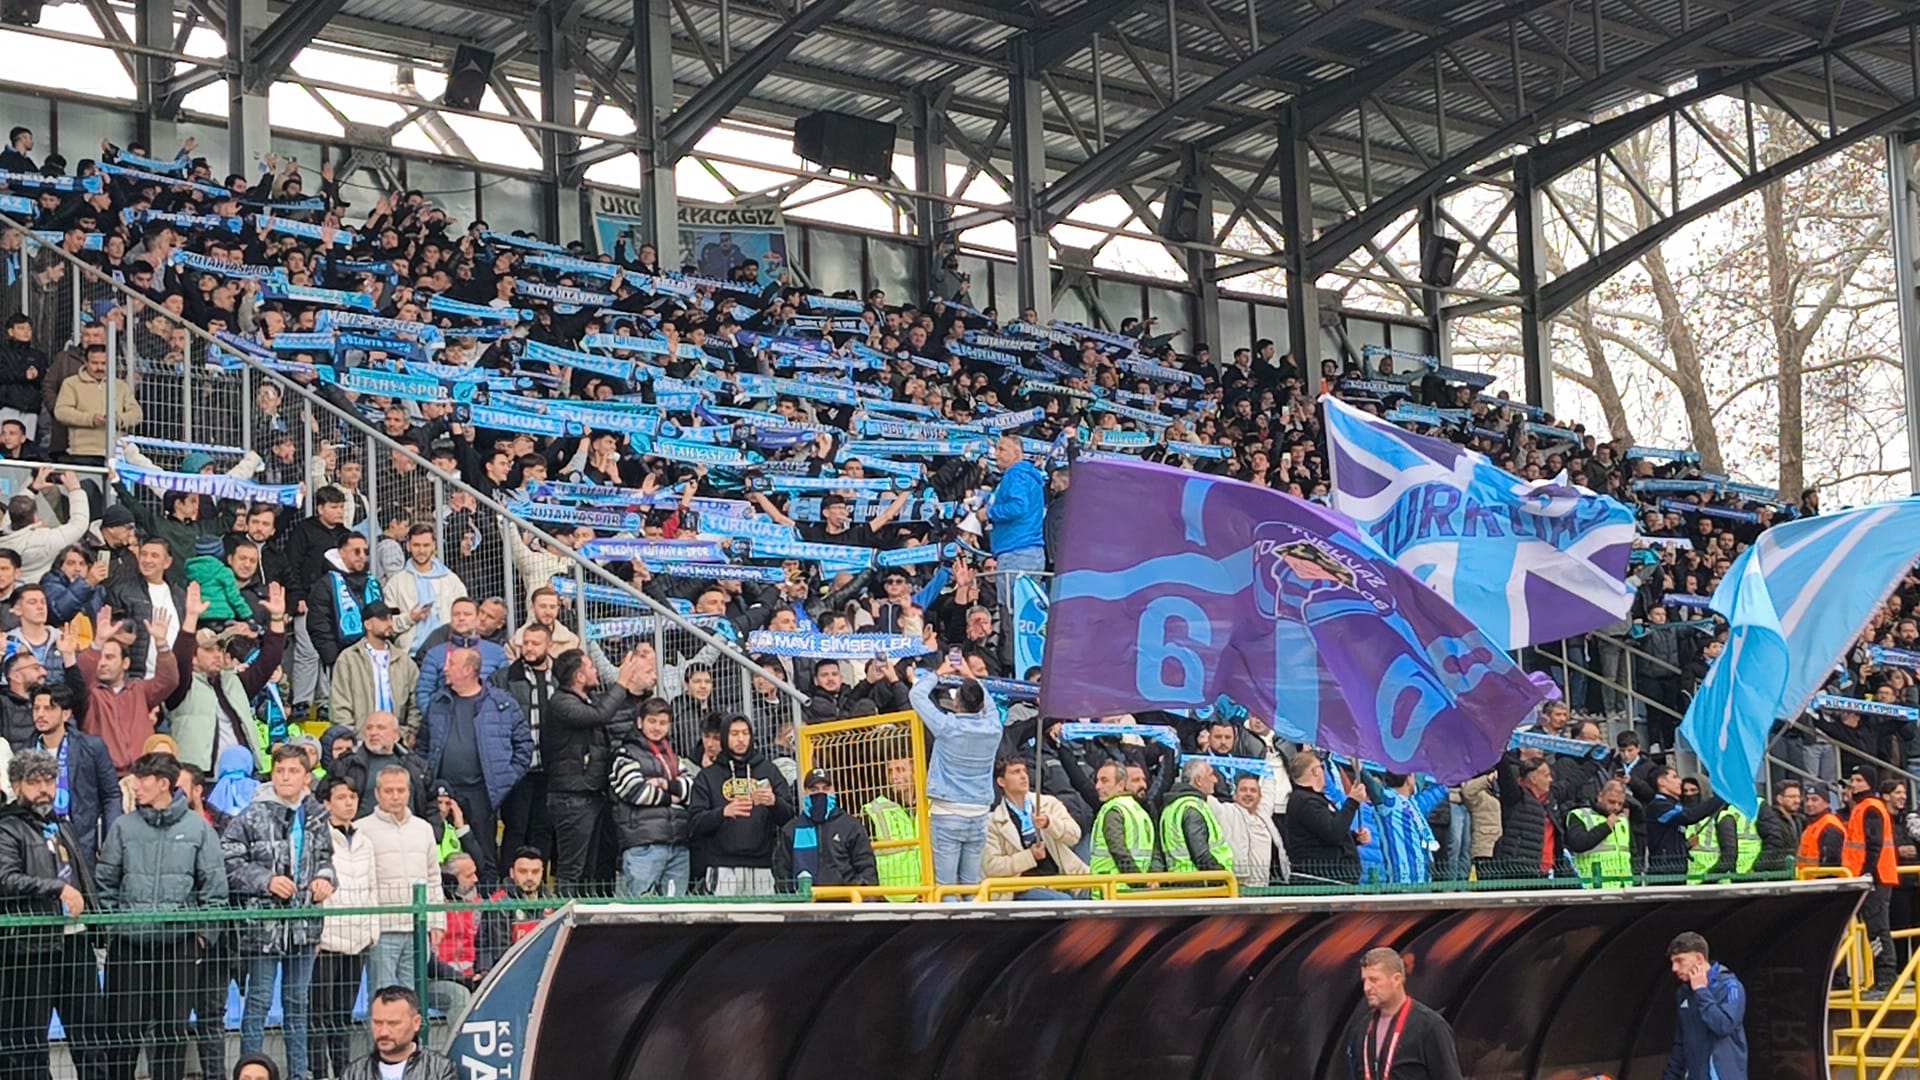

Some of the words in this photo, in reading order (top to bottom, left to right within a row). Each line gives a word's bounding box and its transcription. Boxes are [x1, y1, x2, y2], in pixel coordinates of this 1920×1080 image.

[480, 412, 555, 431] TURKUAZ
[558, 410, 647, 429] TURKUAZ
[709, 515, 783, 538] TURKUAZ
[1136, 595, 1212, 704] 6
